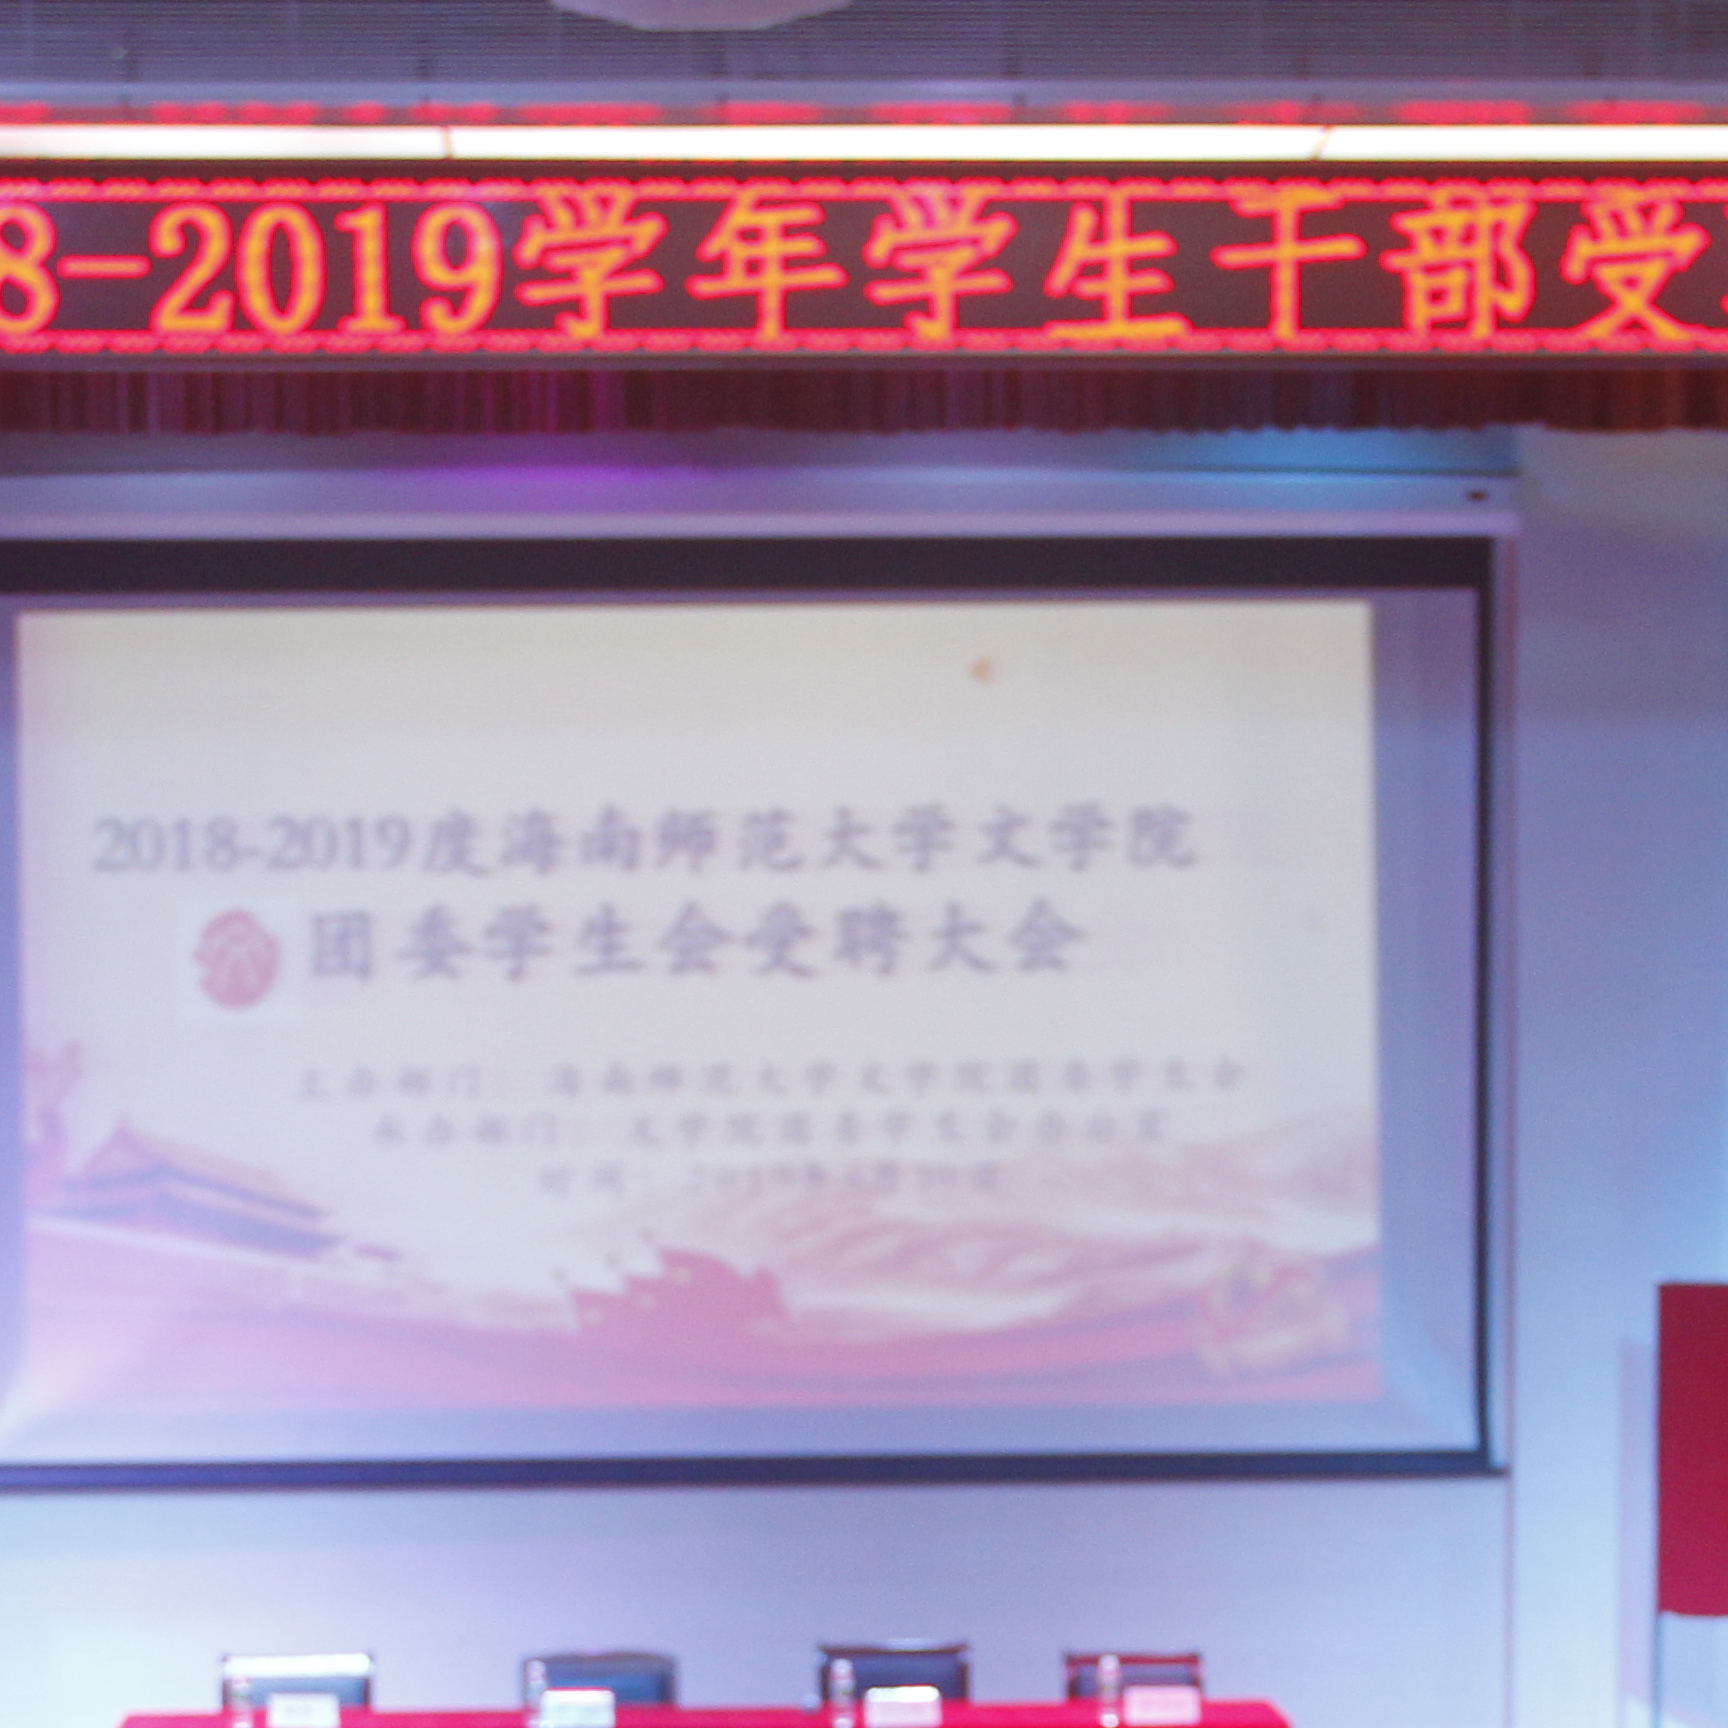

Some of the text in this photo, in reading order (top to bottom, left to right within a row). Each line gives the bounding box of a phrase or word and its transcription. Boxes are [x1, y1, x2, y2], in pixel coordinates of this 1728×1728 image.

[310, 898, 1090, 980] 团委学生会受聘大会
